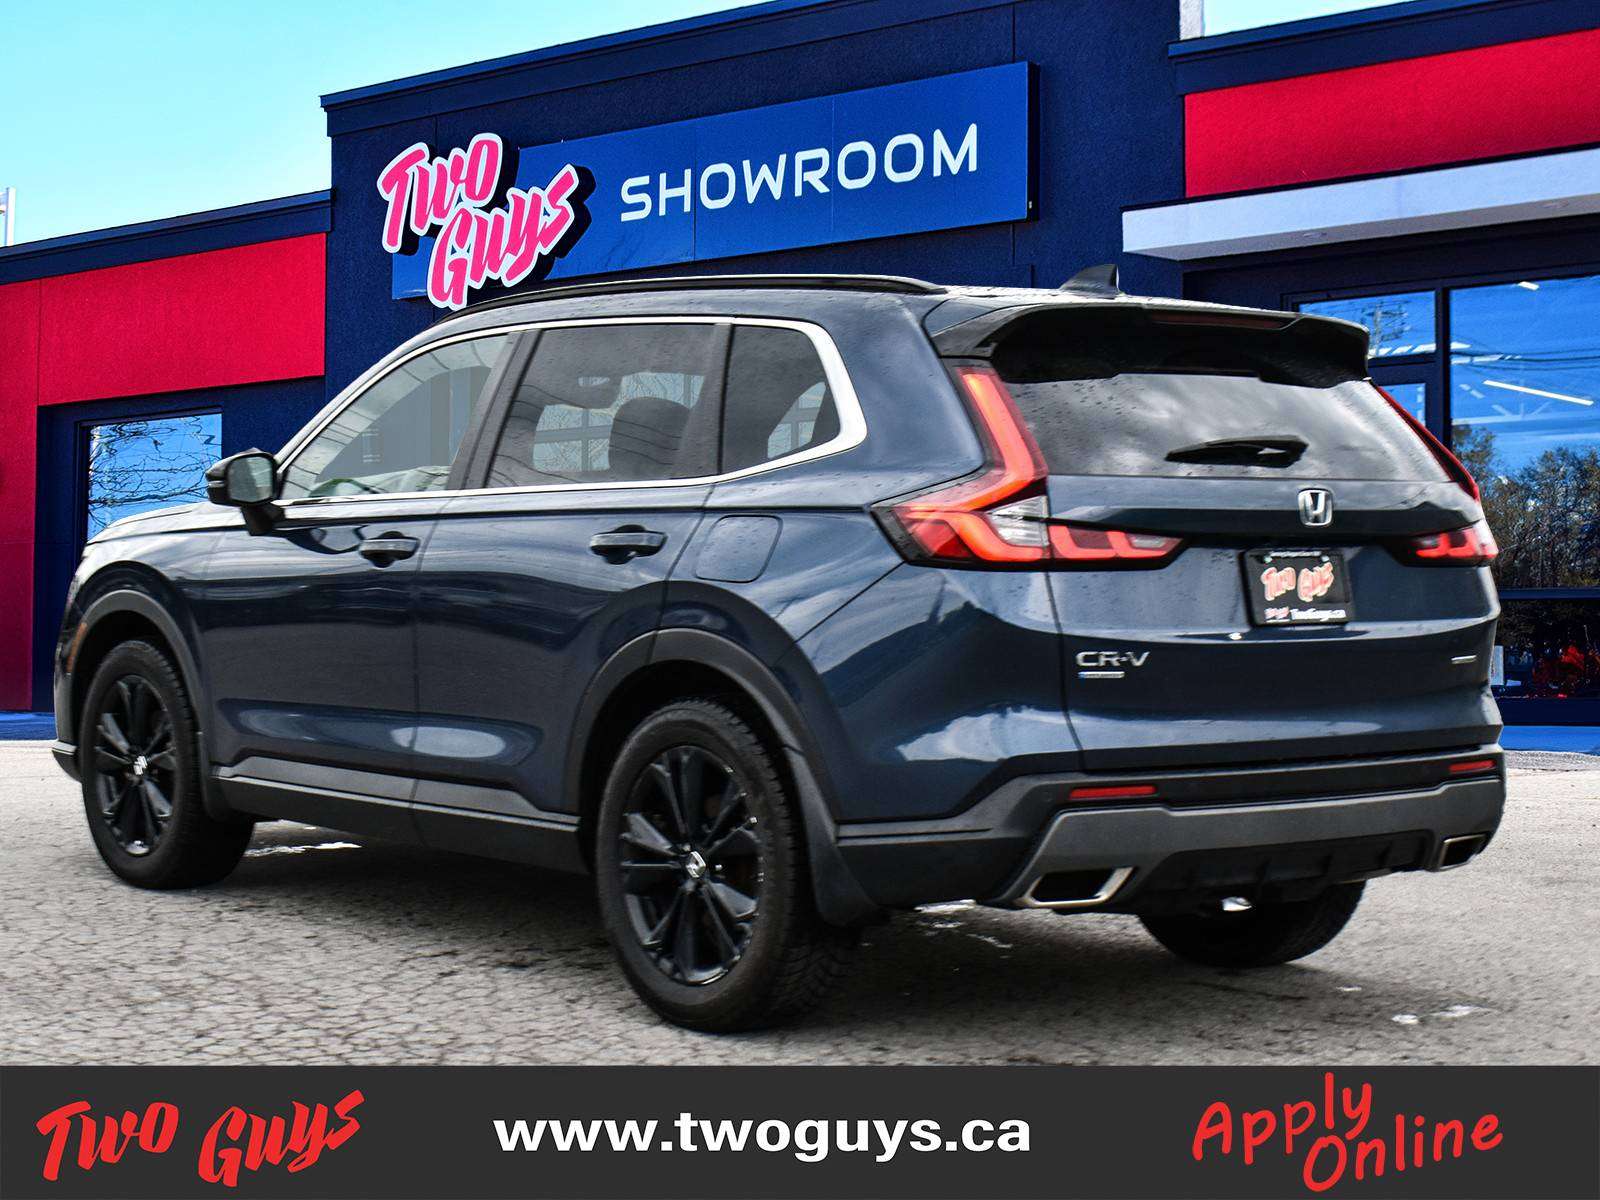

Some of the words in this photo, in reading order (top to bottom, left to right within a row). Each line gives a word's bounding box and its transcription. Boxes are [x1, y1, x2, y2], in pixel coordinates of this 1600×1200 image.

[379, 136, 500, 250] Two
[620, 123, 979, 222] SHOWROOM
[429, 168, 577, 307] Guys
[1075, 650, 1151, 667] CR-V
